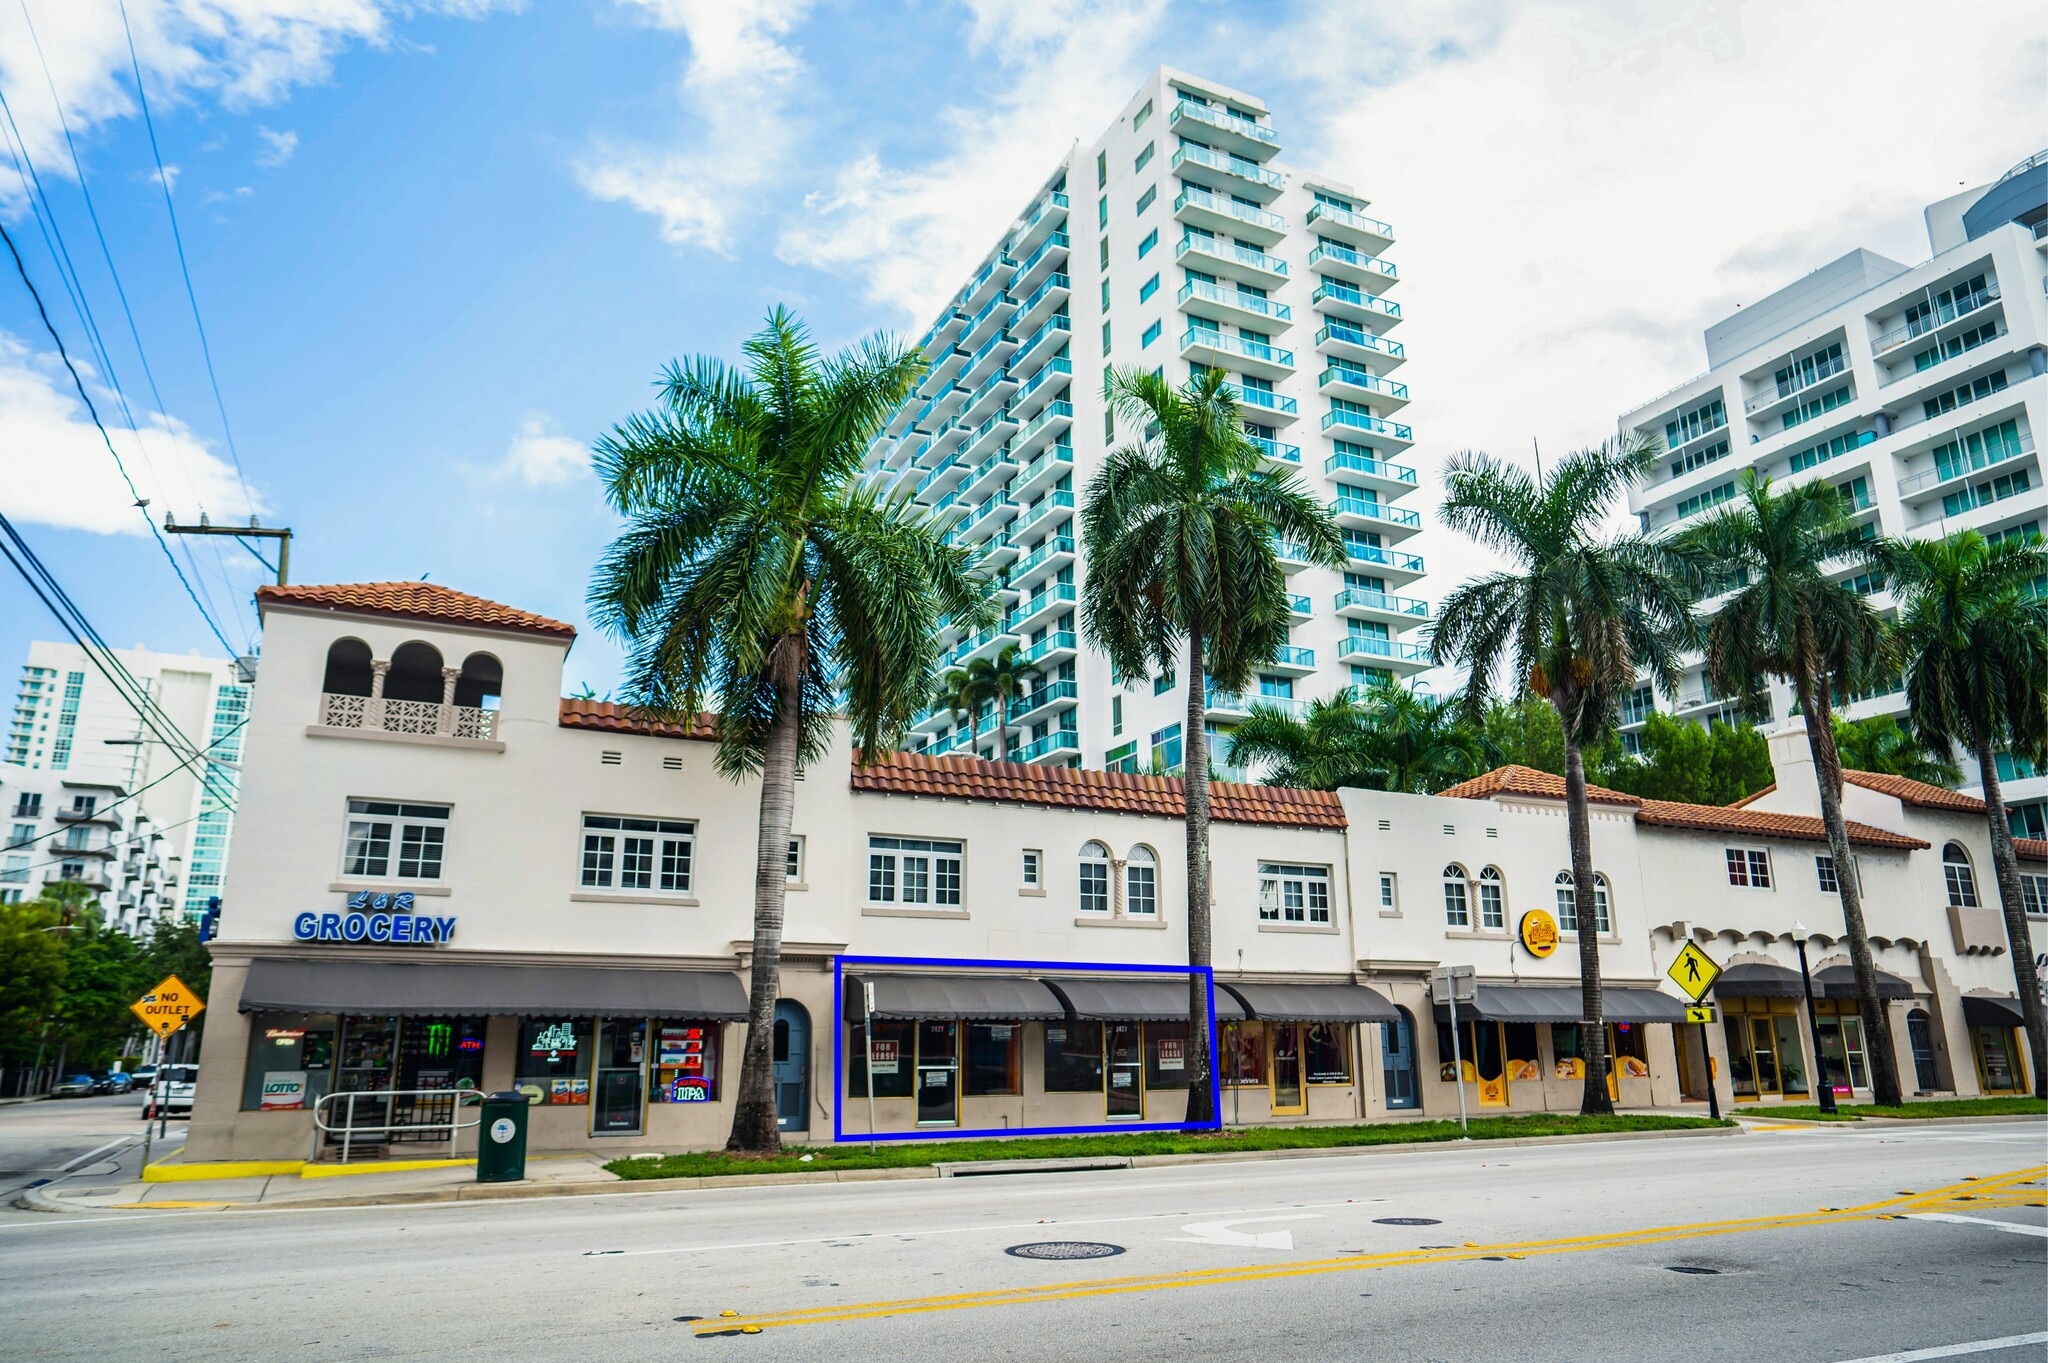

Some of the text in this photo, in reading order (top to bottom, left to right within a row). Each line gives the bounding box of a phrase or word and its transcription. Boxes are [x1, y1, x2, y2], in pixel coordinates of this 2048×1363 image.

[347, 889, 415, 910] L & R
[293, 912, 457, 944] GROCERY
[161, 993, 178, 1002] NO
[145, 1005, 190, 1015] OUTLET
[460, 1041, 481, 1049] ATM
[875, 1042, 891, 1051] FOR
[1164, 1041, 1177, 1050] FOR
[872, 1052, 896, 1060] LEASE
[1161, 1050, 1181, 1058] LEASE
[264, 1083, 300, 1094] LOTTO
[677, 1086, 706, 1101] IPA
